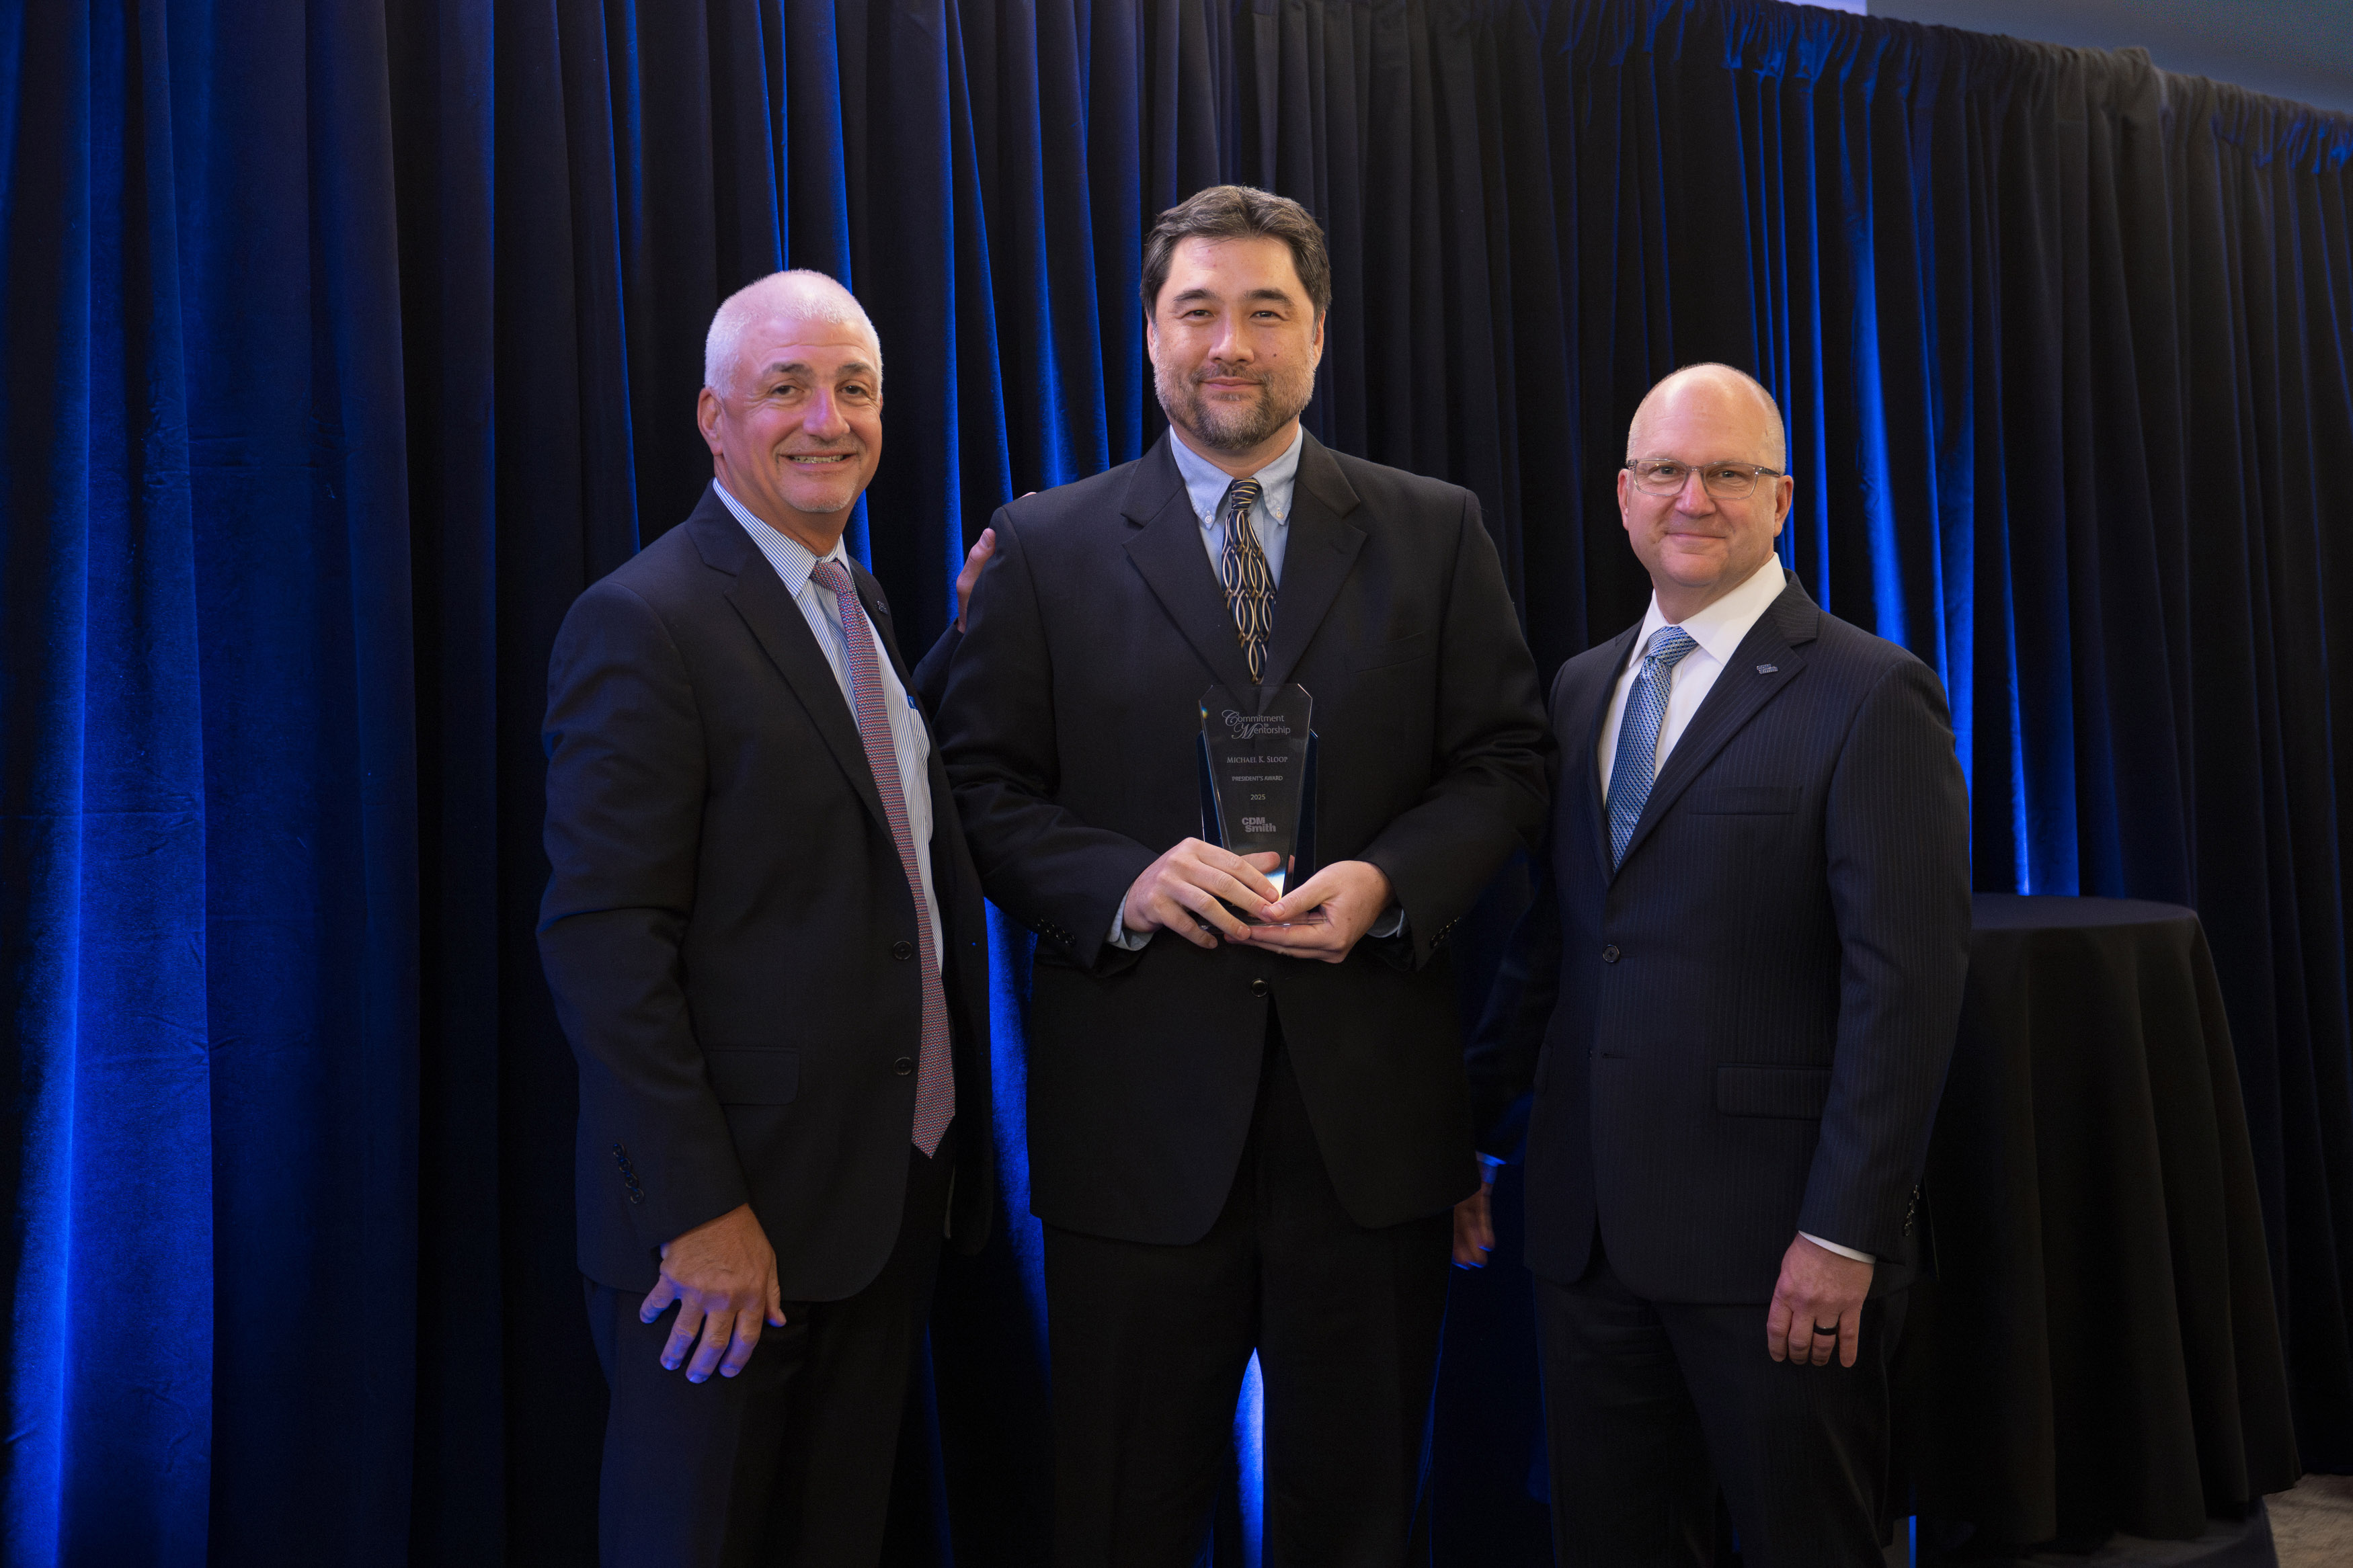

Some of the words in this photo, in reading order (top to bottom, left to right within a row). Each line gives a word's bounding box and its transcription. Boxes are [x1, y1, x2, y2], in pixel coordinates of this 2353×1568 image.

[1222, 710, 1285, 727] Commitment
[1231, 723, 1291, 739] Mentorship
[1242, 817, 1265, 825] CDM
[1245, 823, 1277, 833] Smith
